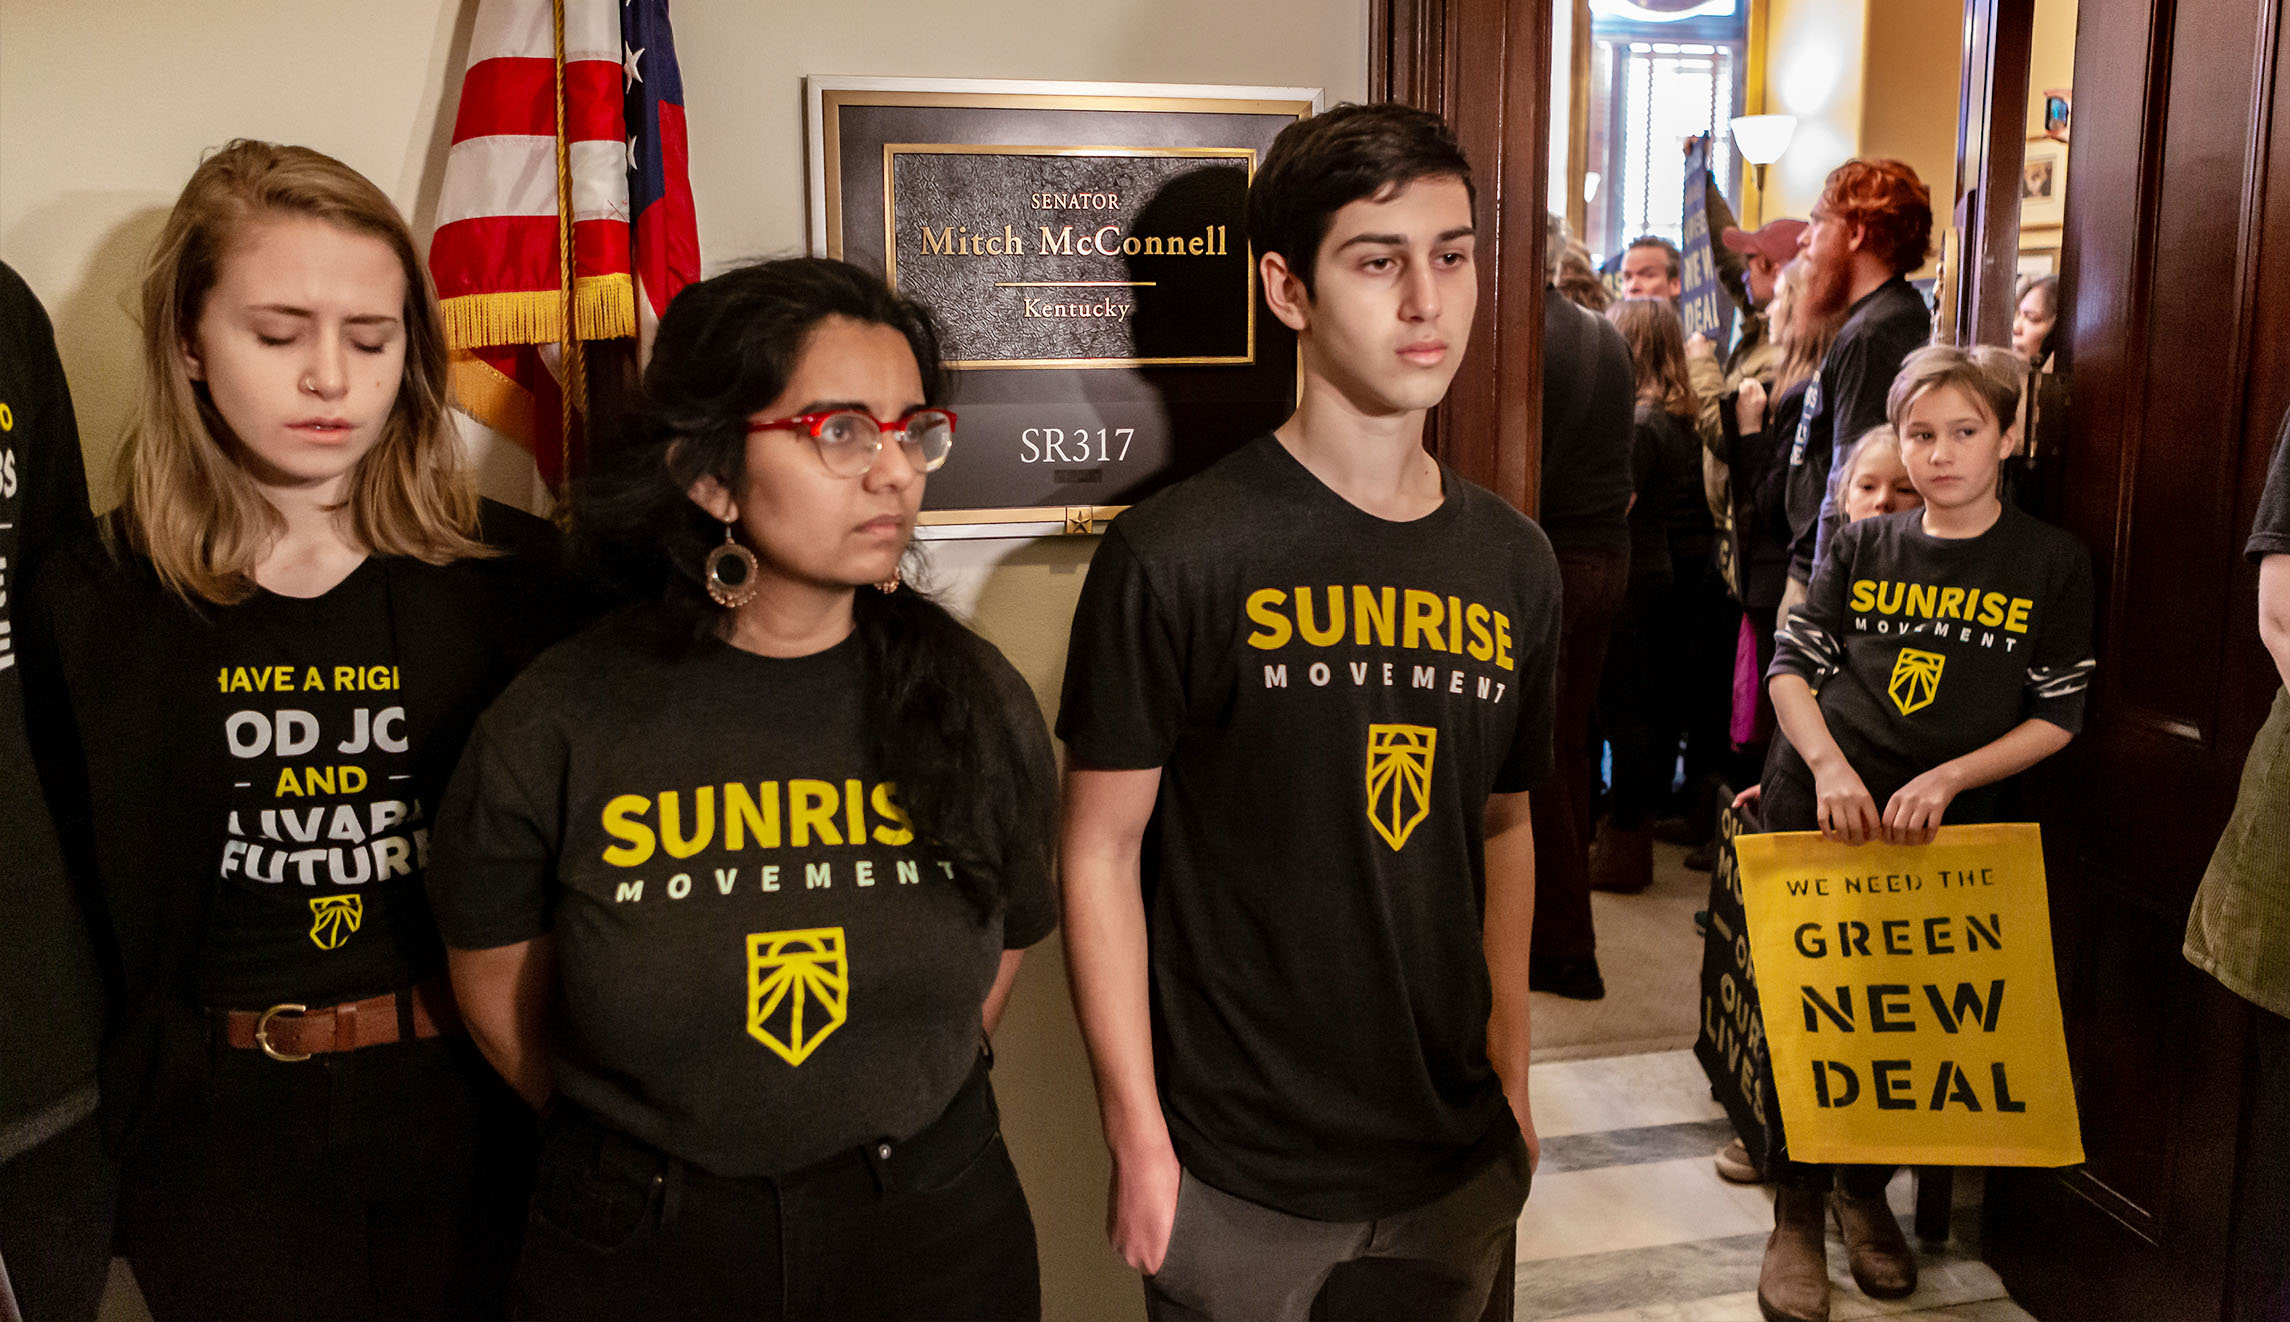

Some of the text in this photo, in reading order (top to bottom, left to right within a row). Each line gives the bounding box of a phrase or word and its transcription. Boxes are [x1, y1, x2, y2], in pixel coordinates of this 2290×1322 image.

[1030, 192, 1121, 211] SENATOR
[919, 224, 1228, 257] Mitch McConnell
[1022, 298, 1131, 323] Kentucky
[1019, 427, 1136, 464] SR317
[1245, 584, 1515, 671] SUNRISE
[1849, 578, 2034, 634] SUNRISE
[303, 665, 326, 692] A
[1263, 661, 1507, 704] MOVEMENT
[275, 765, 369, 798] AND
[601, 778, 915, 868] SUNRIS
[614, 859, 957, 903] MOVEMENT
[1786, 868, 1995, 897] WE NEED THE
[1793, 913, 2003, 959] GREEN
[1800, 979, 2006, 1034] NEW
[1811, 1059, 2027, 1114] DEAL
